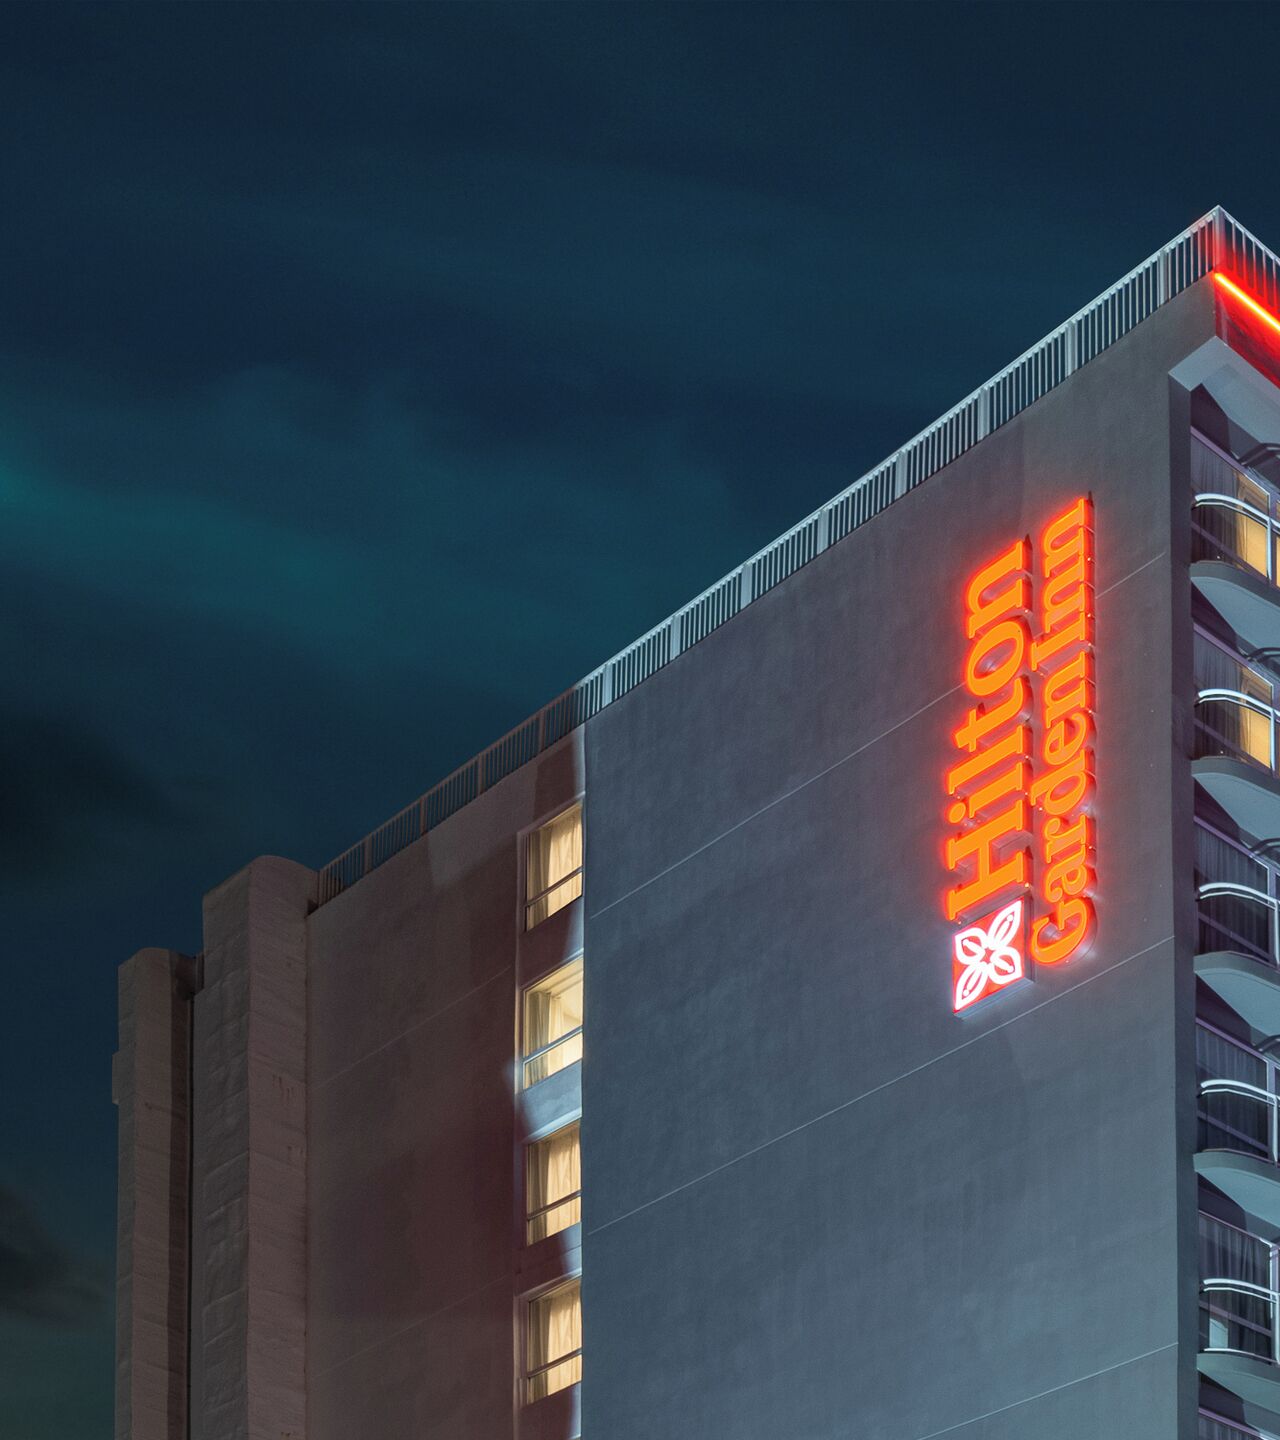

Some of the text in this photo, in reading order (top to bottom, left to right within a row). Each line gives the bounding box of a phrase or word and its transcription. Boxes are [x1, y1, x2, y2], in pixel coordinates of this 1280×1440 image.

[945, 540, 1027, 922] Hilton
[1030, 498, 1089, 965] Garden Inn
